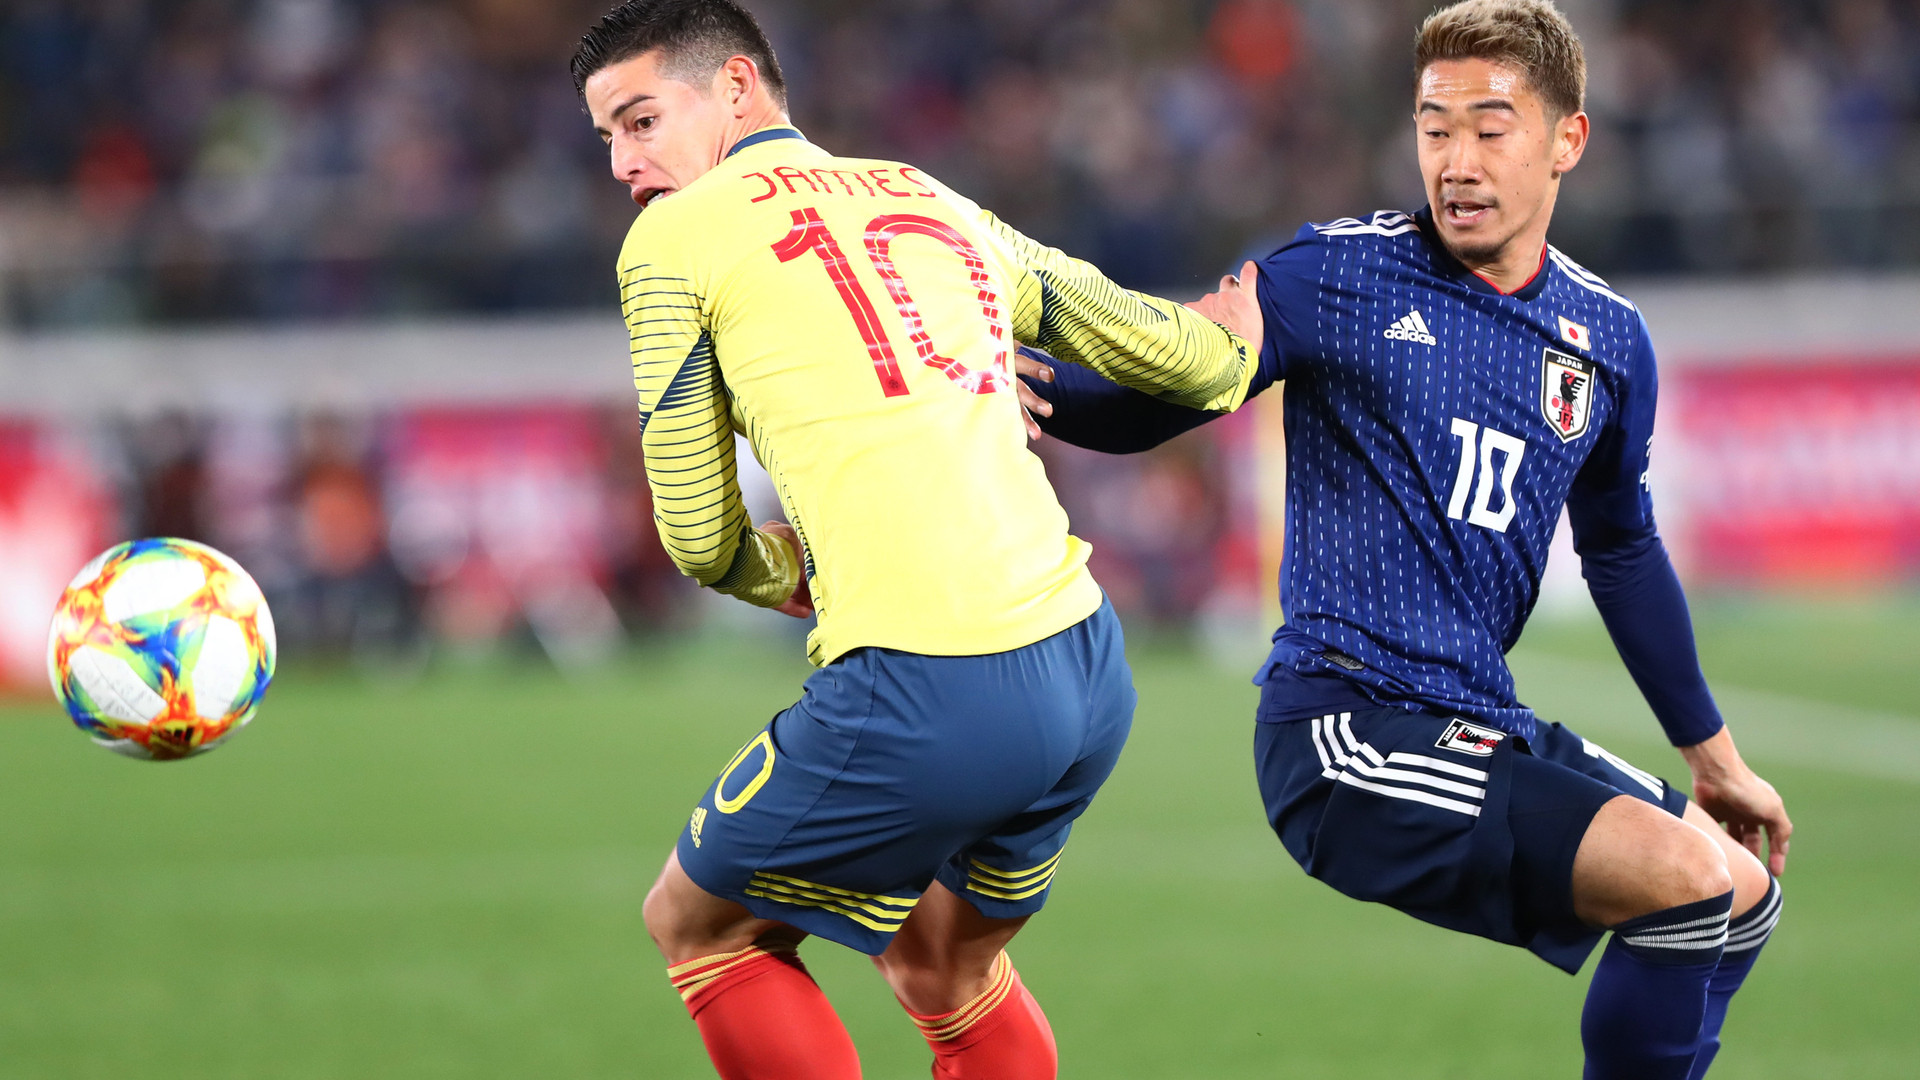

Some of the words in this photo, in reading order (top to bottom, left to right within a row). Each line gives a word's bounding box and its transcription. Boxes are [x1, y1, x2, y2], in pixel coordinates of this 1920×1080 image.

[742, 166, 936, 203] JAMES
[770, 207, 1009, 398] 10
[1383, 327, 1437, 346] adidas
[1556, 356, 1583, 370] JAPAN
[1556, 411, 1575, 428] JFA
[1447, 417, 1526, 533] 10
[714, 730, 776, 814] 0
